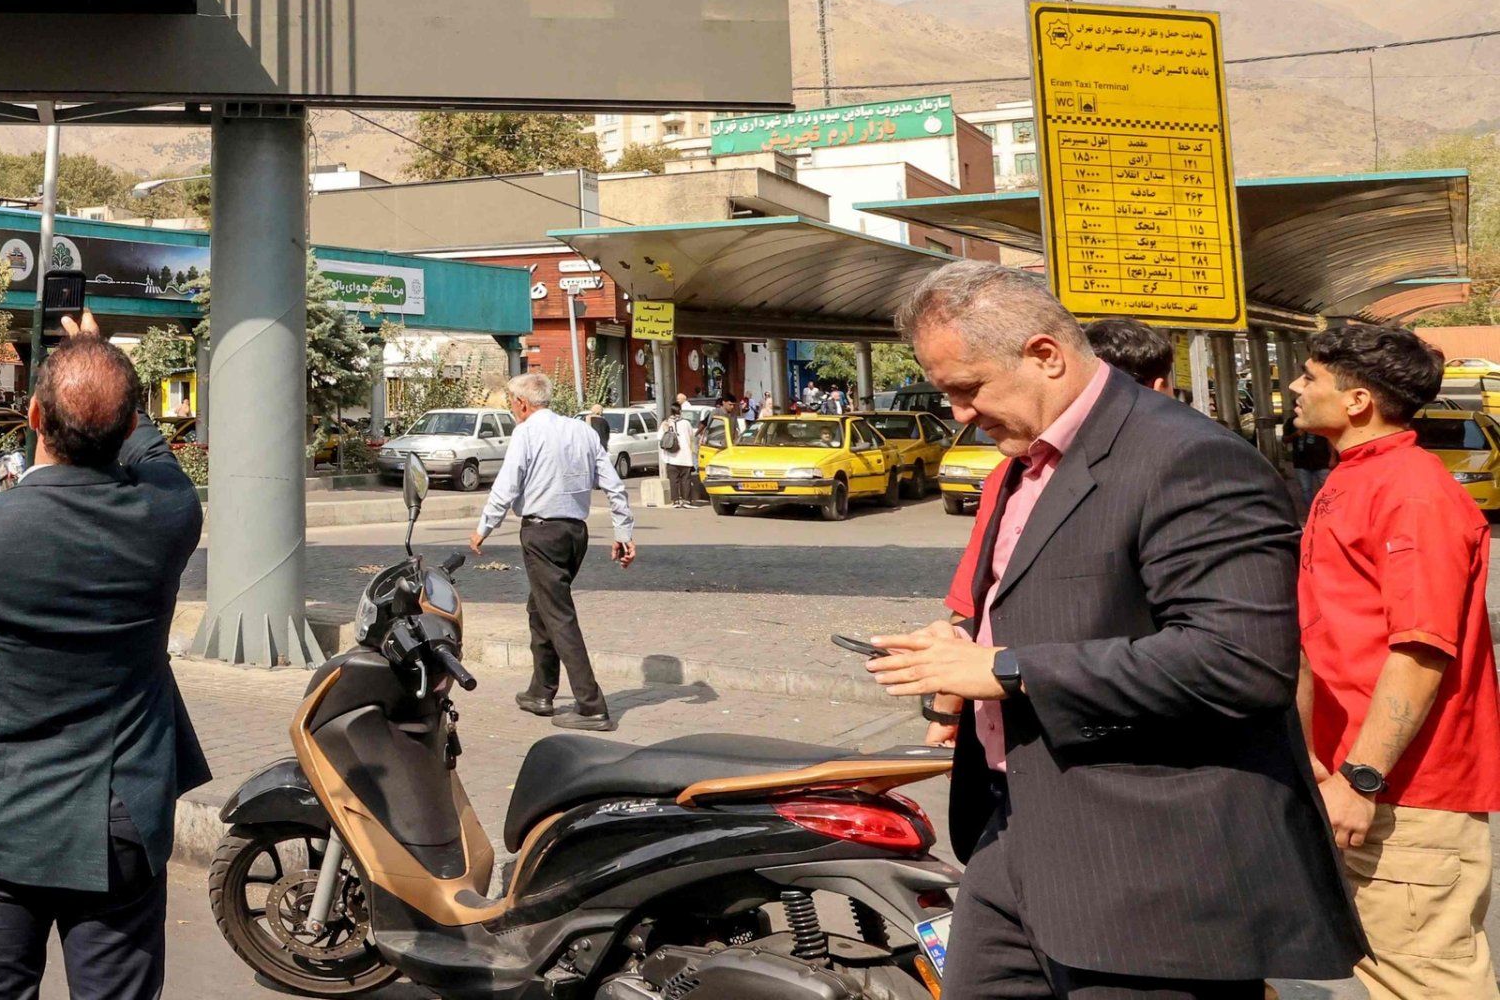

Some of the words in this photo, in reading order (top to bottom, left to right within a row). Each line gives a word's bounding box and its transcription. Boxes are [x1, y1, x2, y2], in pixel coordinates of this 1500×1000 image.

[1160, 47, 1183, 56] مدیریت
[1185, 48, 1207, 57] سازمان
[1132, 63, 1145, 74] ارم
[1152, 65, 1188, 76] تاکسیرانی
[1050, 78, 1072, 87] Eram
[1075, 80, 1091, 88] Taxi
[1093, 81, 1129, 91] Terminal
[914, 97, 951, 114] سازمان
[1056, 98, 1074, 107] WC
[841, 105, 874, 121] میادین
[876, 102, 912, 117] مدیریت
[819, 111, 840, 124] میوه
[712, 120, 737, 135] تهران
[739, 116, 781, 132] شهرداری
[828, 122, 855, 146] ارم
[860, 119, 897, 143] بازار
[762, 125, 821, 151] تجریش
[1091, 136, 1108, 147] طول
[1177, 142, 1191, 151] خط
[1193, 143, 1203, 151] کد
[1074, 152, 1098, 162] ۱۸۵۰۰
[1076, 169, 1099, 178] ۱۷۰۰۰
[1116, 169, 1139, 179] انقلاب
[1183, 174, 1202, 184] ۶۴۸
[1077, 184, 1099, 193] ۱۹۰۰۰
[1131, 188, 1156, 199] صادقیه
[1188, 208, 1203, 217] ۱۱۶
[1082, 220, 1101, 229] ۵۰۰۰
[1134, 221, 1160, 233] ولنجک
[1190, 225, 1204, 235] ۱۱۵
[1083, 265, 1107, 274] ۱۴۰۰۰
[345, 281, 369, 295] هوای
[1084, 280, 1110, 290] ۵۴۰۰۰
[1142, 282, 1158, 293] کرج
[393, 288, 404, 298] من
